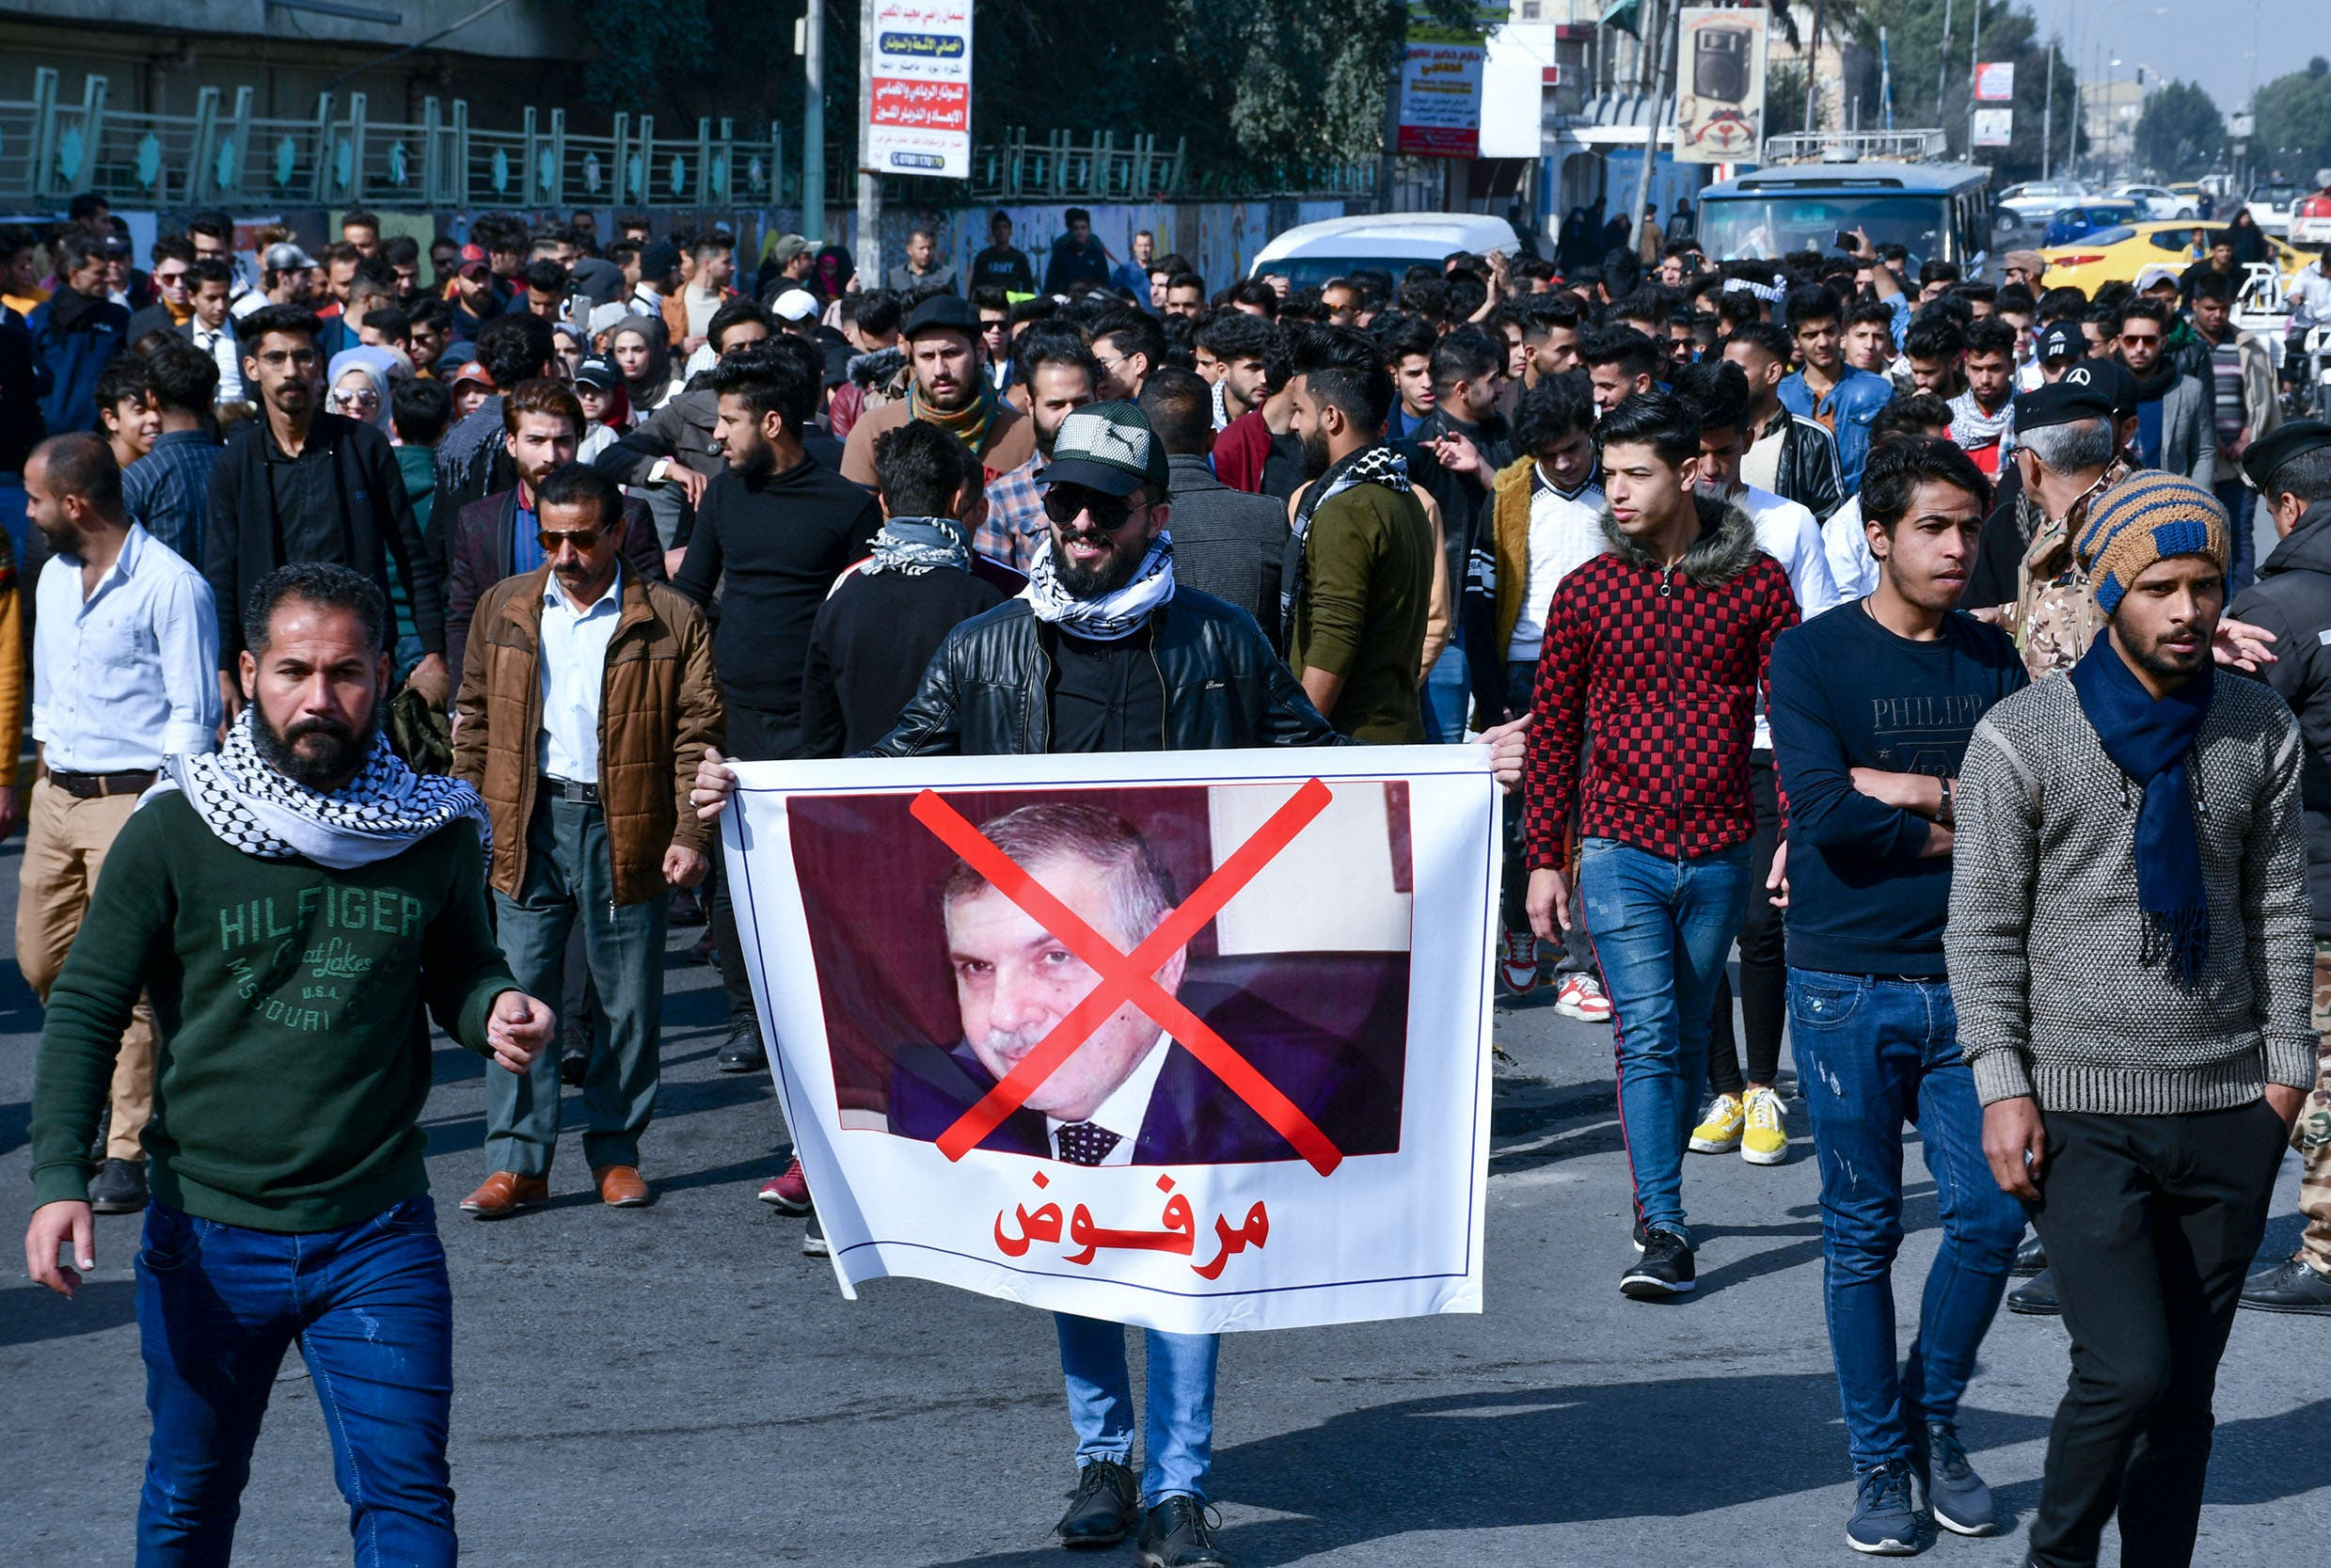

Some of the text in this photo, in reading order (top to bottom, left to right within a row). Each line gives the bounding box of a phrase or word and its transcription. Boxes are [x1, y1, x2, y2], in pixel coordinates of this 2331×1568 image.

[1871, 693, 1983, 729] PHILIPP
[219, 886, 423, 951] HILFIGER
[312, 936, 373, 978] Lakes
